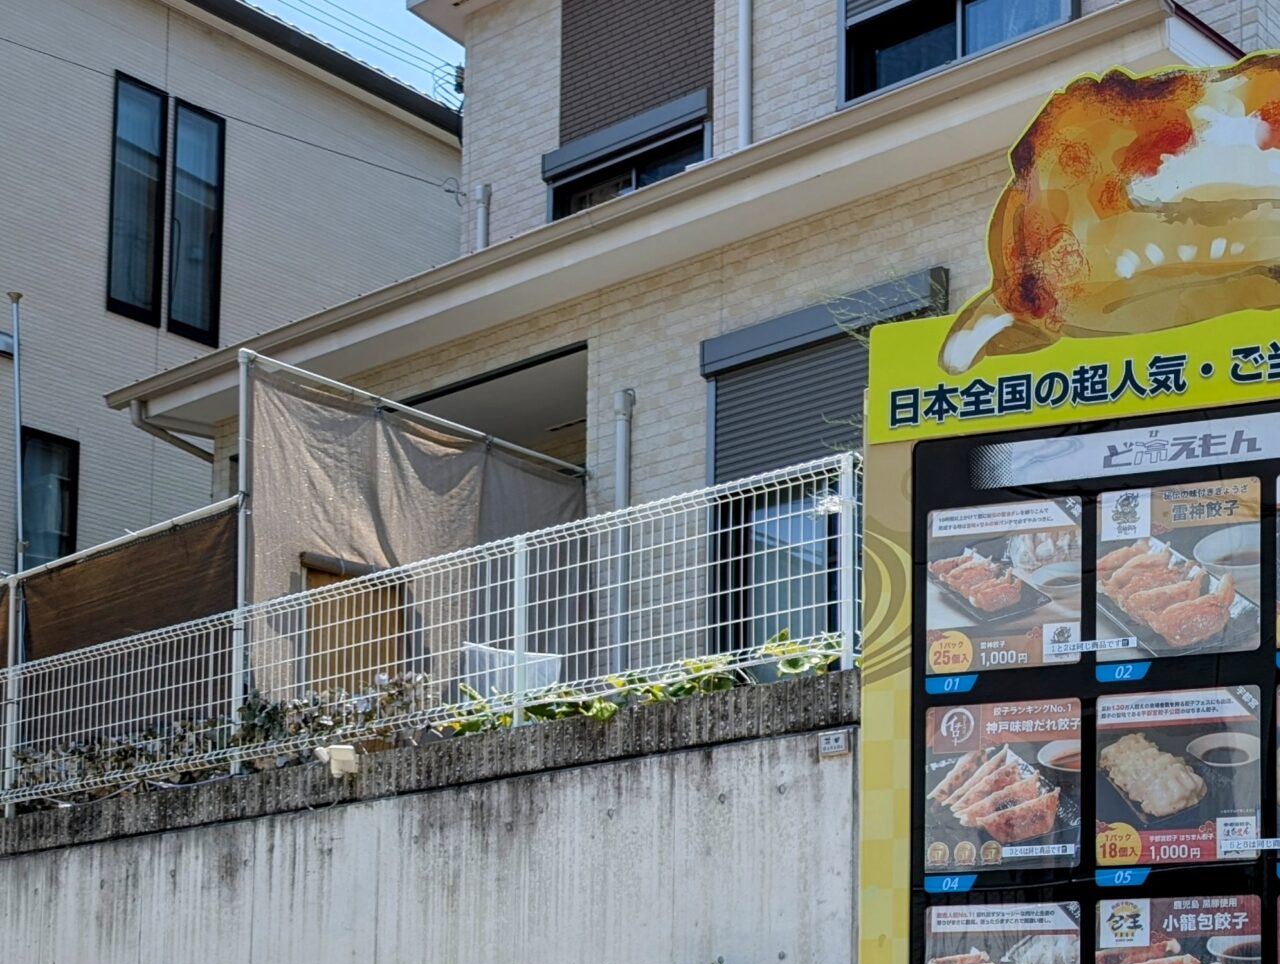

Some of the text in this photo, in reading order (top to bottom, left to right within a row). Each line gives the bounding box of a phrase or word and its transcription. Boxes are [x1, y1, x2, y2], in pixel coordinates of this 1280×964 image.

[1102, 430, 1262, 469] ど冷えもん
[1171, 500, 1240, 522] 雷神餃子
[939, 641, 964, 650] 1パック
[933, 650, 970, 667] 25個入
[979, 650, 1028, 668] 1,000円
[1114, 665, 1133, 679] 02
[943, 678, 961, 691] 01
[993, 703, 1073, 716] 餃子ランキングNo.1
[985, 717, 1081, 735] 神戸味噌だれ餃子
[1104, 833, 1132, 842] 1パック
[1099, 844, 1138, 859] 18個入
[1149, 844, 1200, 860] 1,000円
[942, 877, 960, 891] 04
[1114, 870, 1132, 884] 05
[1162, 912, 1249, 932] 小籠包餃子
